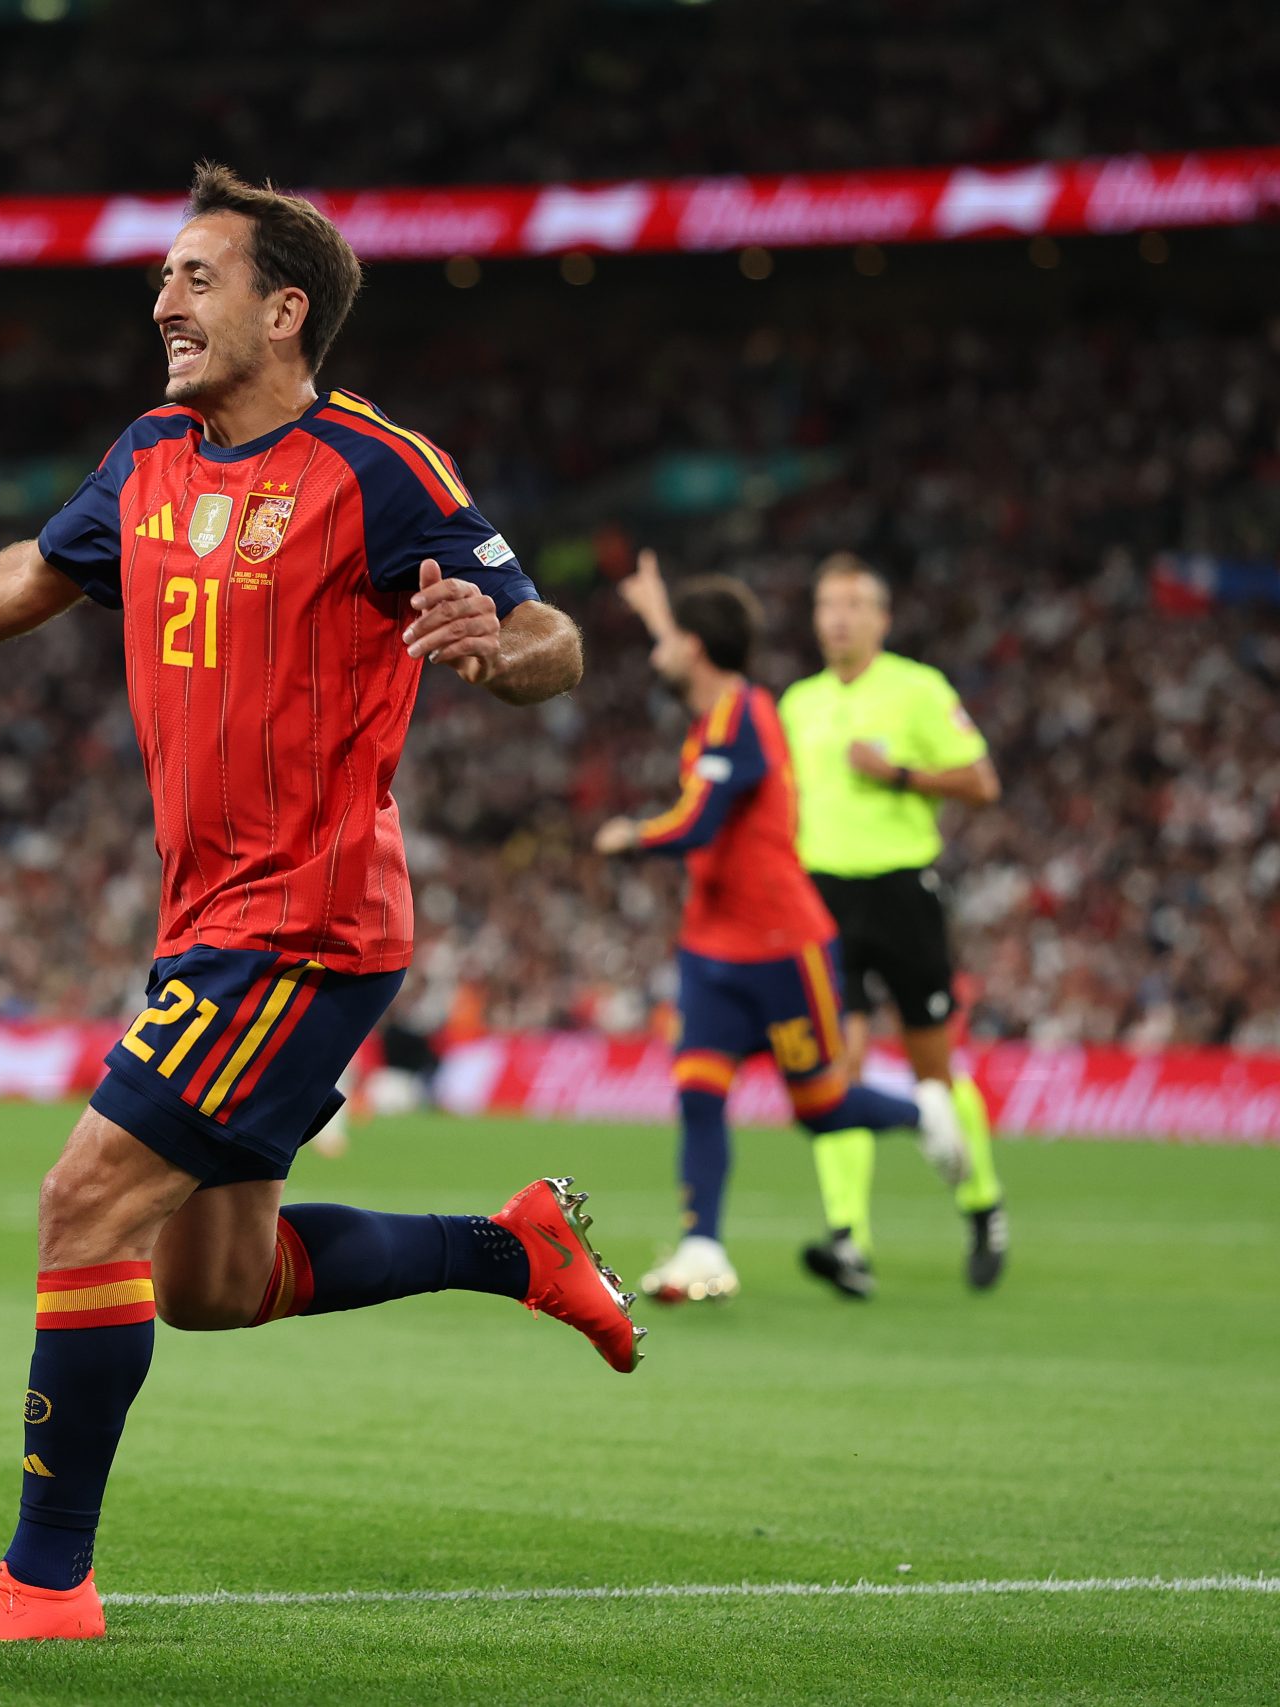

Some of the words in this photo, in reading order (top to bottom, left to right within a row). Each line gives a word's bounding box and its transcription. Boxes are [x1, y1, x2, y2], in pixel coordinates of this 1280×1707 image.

[162, 576, 220, 668] 21
[121, 978, 220, 1080] 21
[767, 1016, 818, 1073] 15
